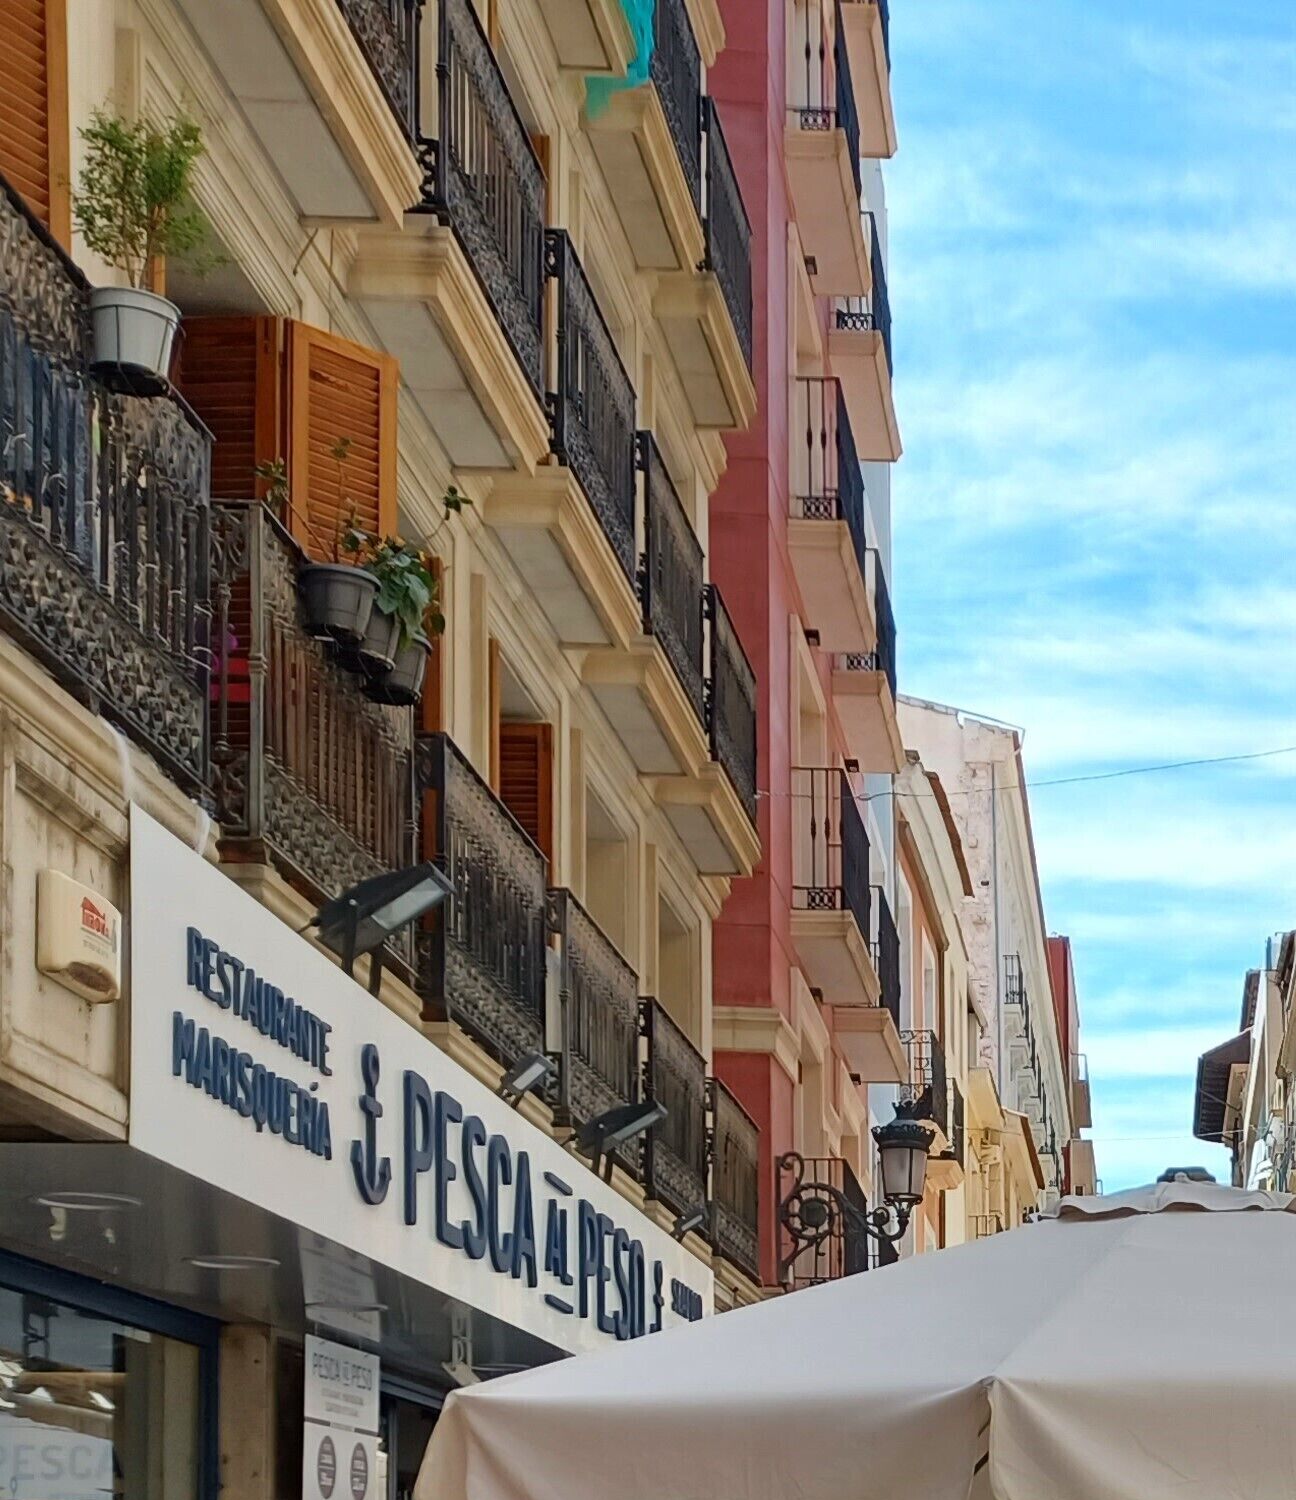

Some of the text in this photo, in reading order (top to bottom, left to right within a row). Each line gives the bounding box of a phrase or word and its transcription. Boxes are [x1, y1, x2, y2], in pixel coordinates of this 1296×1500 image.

[187, 926, 332, 1076] RESTAURANTE
[173, 1011, 332, 1160] MARISQUERÍA
[403, 1069, 646, 1340] PESCA AL PESO
